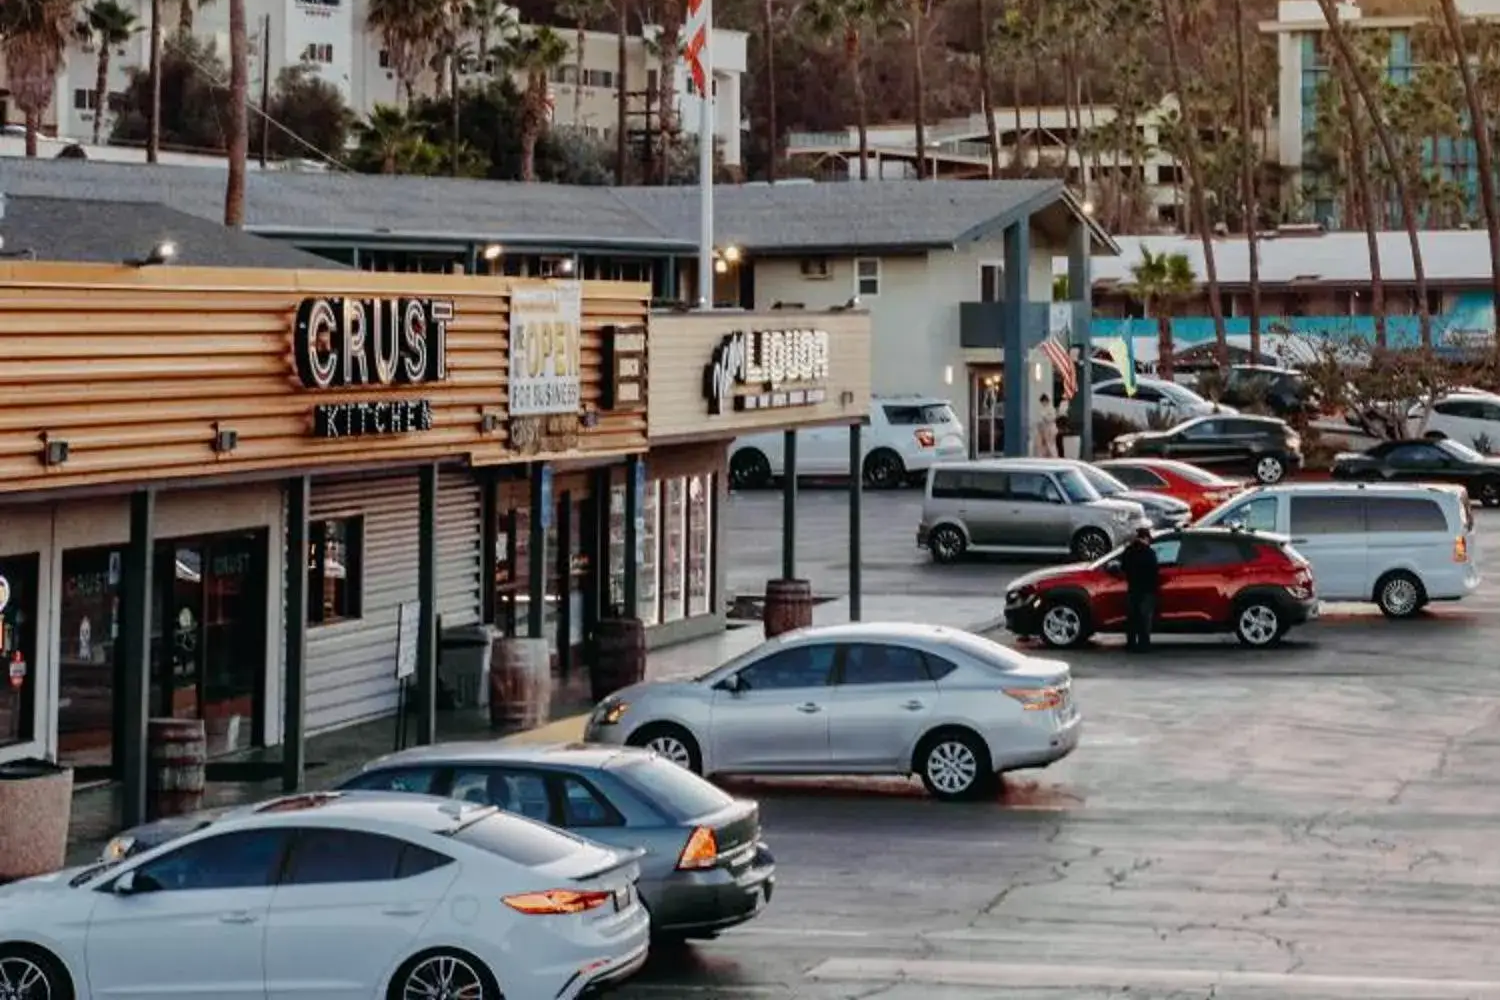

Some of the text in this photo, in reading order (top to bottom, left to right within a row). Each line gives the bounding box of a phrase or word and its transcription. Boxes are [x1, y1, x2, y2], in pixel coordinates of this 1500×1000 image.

[299, 297, 455, 388] CRUST
[526, 322, 578, 378] OPEN
[745, 330, 829, 390] LIQUOR
[326, 399, 432, 438] KITCHEN
